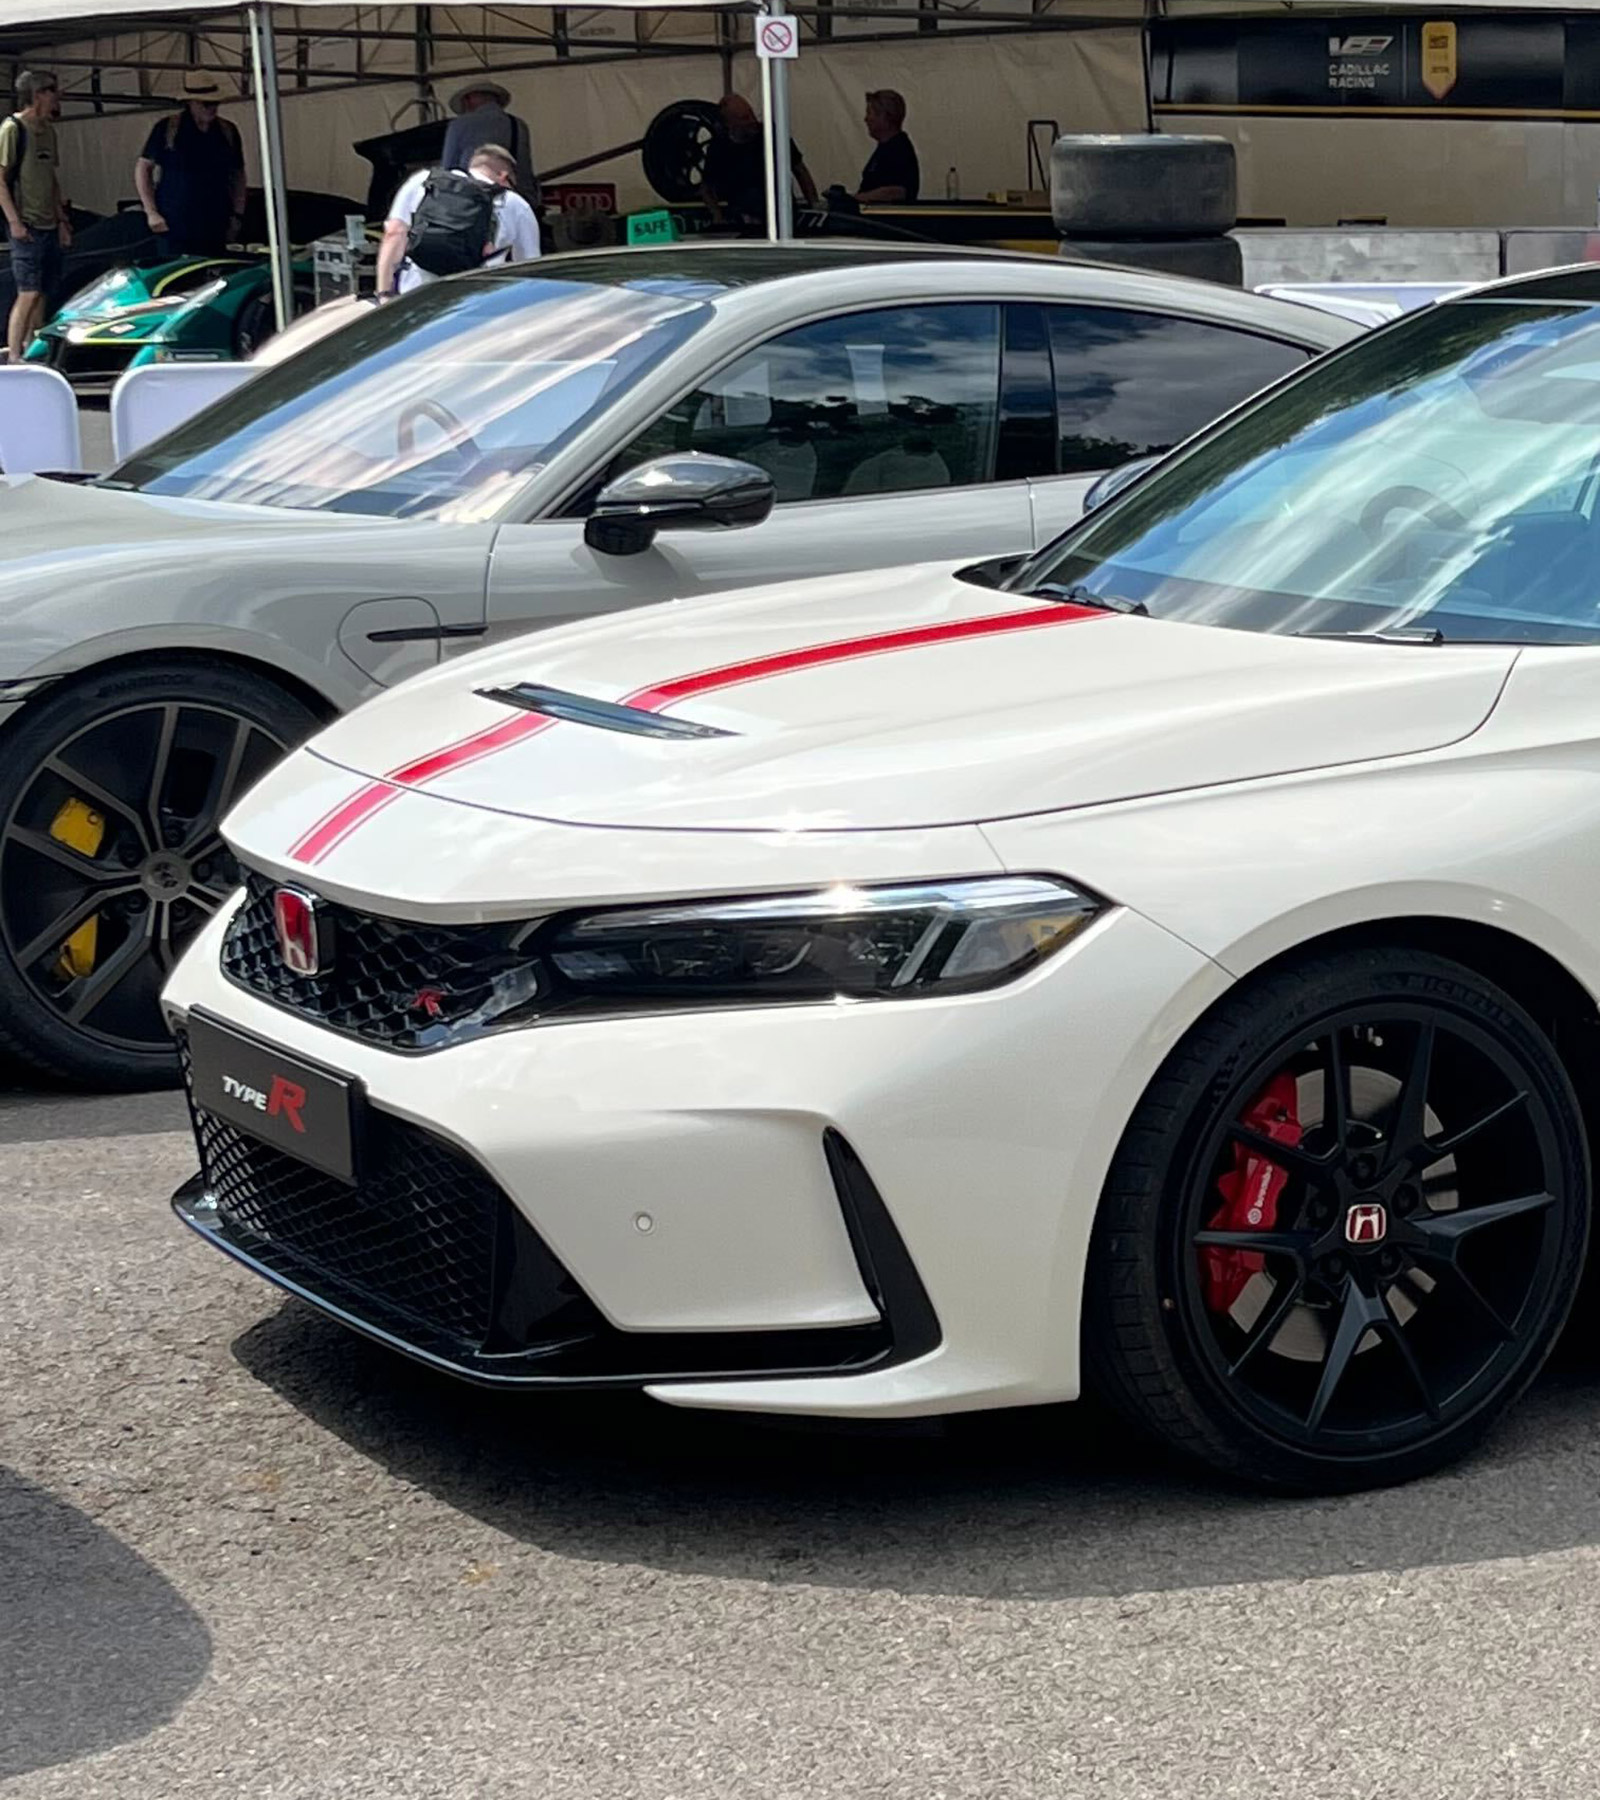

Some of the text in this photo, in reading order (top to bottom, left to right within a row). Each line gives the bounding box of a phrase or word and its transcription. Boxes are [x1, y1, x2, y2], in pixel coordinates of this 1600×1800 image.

[1329, 63, 1390, 76] CADILLAC
[1329, 76, 1376, 88] RACING
[633, 219, 669, 237] SAFE
[222, 1074, 307, 1133] TYPE R
